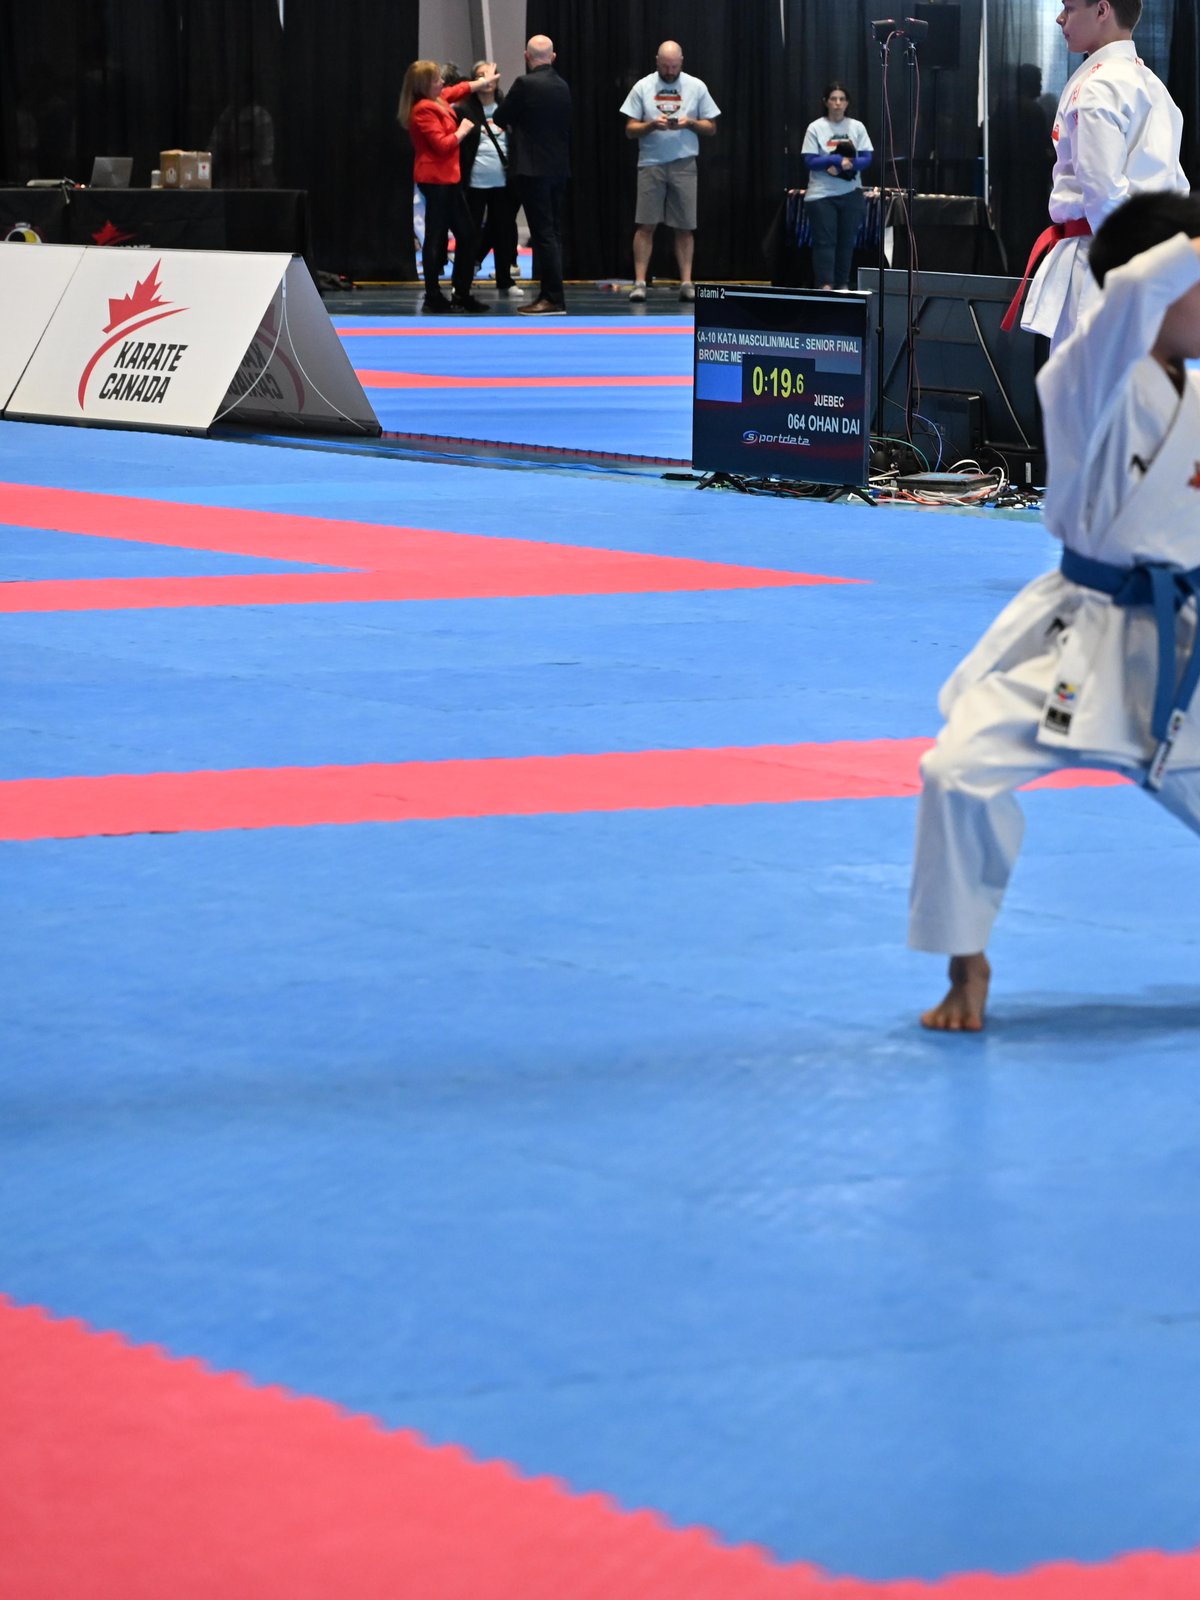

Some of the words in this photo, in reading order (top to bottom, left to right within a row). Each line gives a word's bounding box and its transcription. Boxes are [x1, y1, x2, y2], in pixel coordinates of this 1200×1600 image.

[720, 288, 725, 299] 2
[718, 332, 737, 345] KATA
[739, 334, 800, 349] MASCULIN/MALE
[806, 338, 835, 352] SENIOR
[837, 340, 859, 353] FINAL
[114, 341, 189, 372] KARATE
[699, 349, 729, 362] BRONZE
[98, 373, 171, 404] CANADA
[752, 366, 804, 398] 0:19.6
[788, 413, 806, 430] 064
[808, 415, 839, 433] OHAN
[842, 417, 860, 435] DAI
